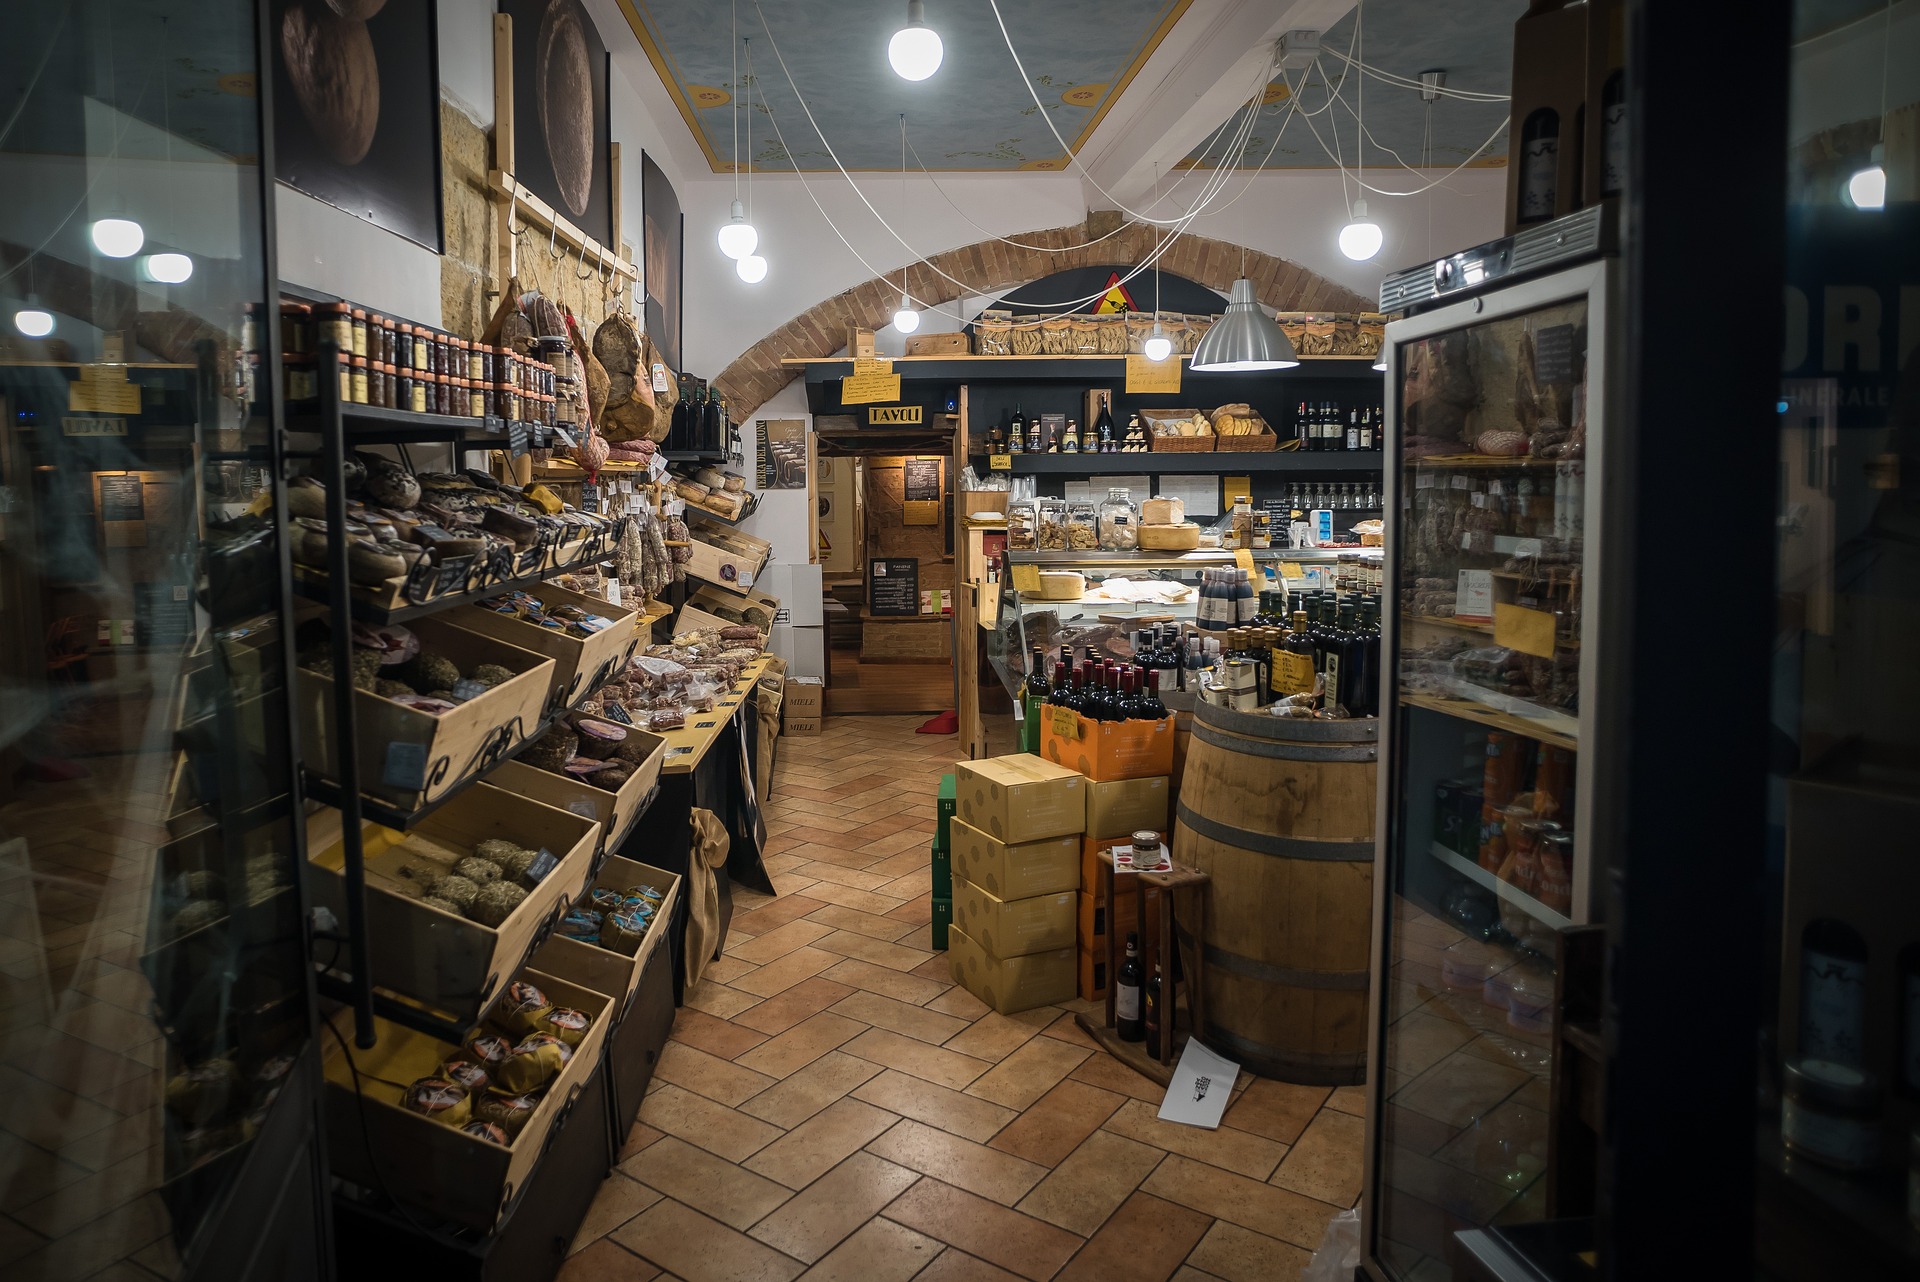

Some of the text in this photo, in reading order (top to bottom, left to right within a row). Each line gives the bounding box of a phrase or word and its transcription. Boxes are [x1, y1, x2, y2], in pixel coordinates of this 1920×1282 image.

[871, 408, 919, 422] TAVOLI
[756, 447, 766, 463] DEL
[756, 463, 766, 488] TERRA
[789, 698, 816, 706] MIELE
[789, 723, 815, 731] MIELE
